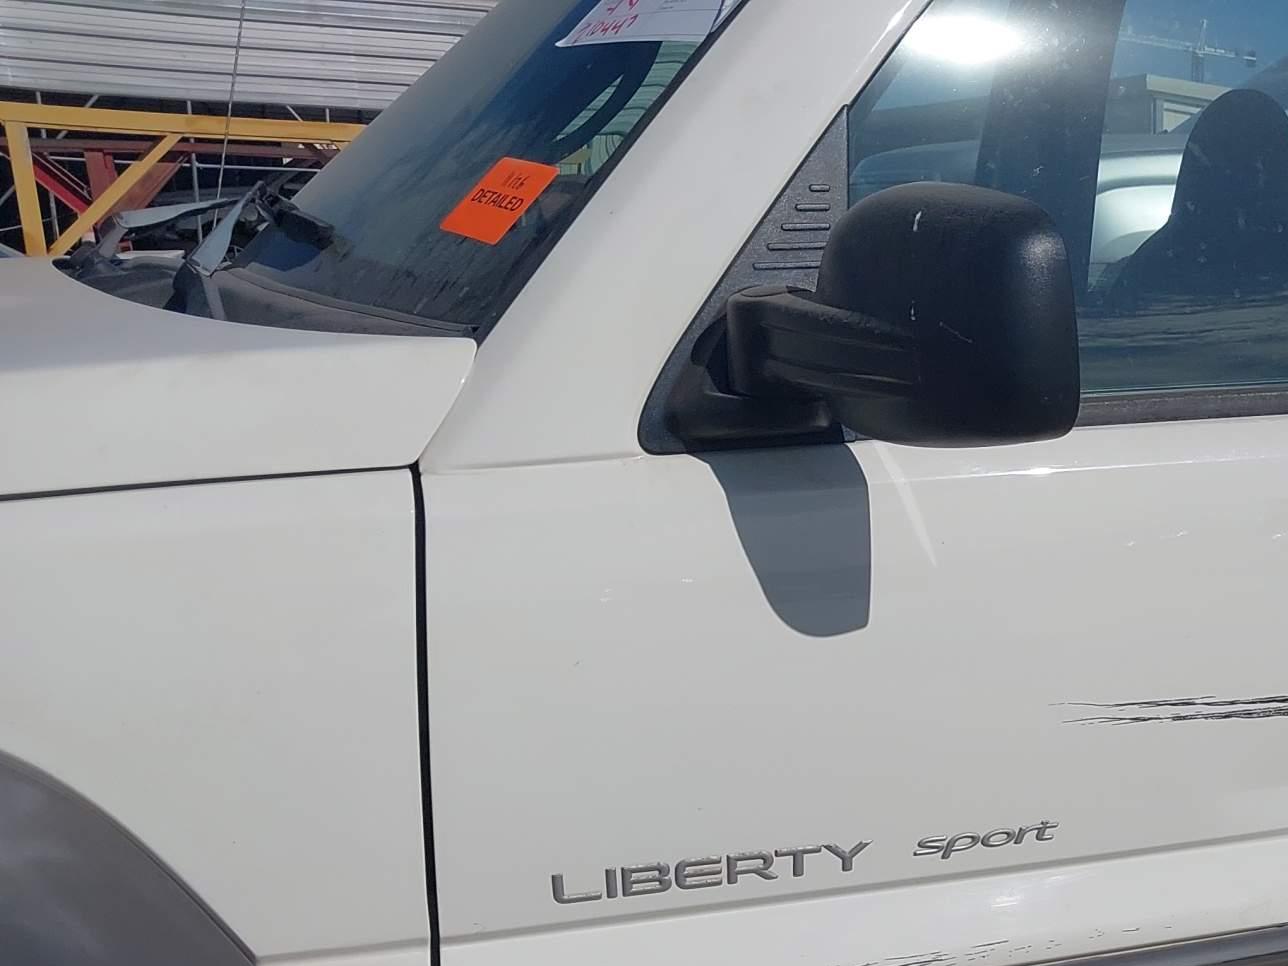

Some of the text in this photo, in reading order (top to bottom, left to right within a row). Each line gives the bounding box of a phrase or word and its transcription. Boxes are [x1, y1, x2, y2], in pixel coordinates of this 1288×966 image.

[471, 188, 524, 212] DETAILED
[551, 819, 1060, 904] LIBERTY sport
